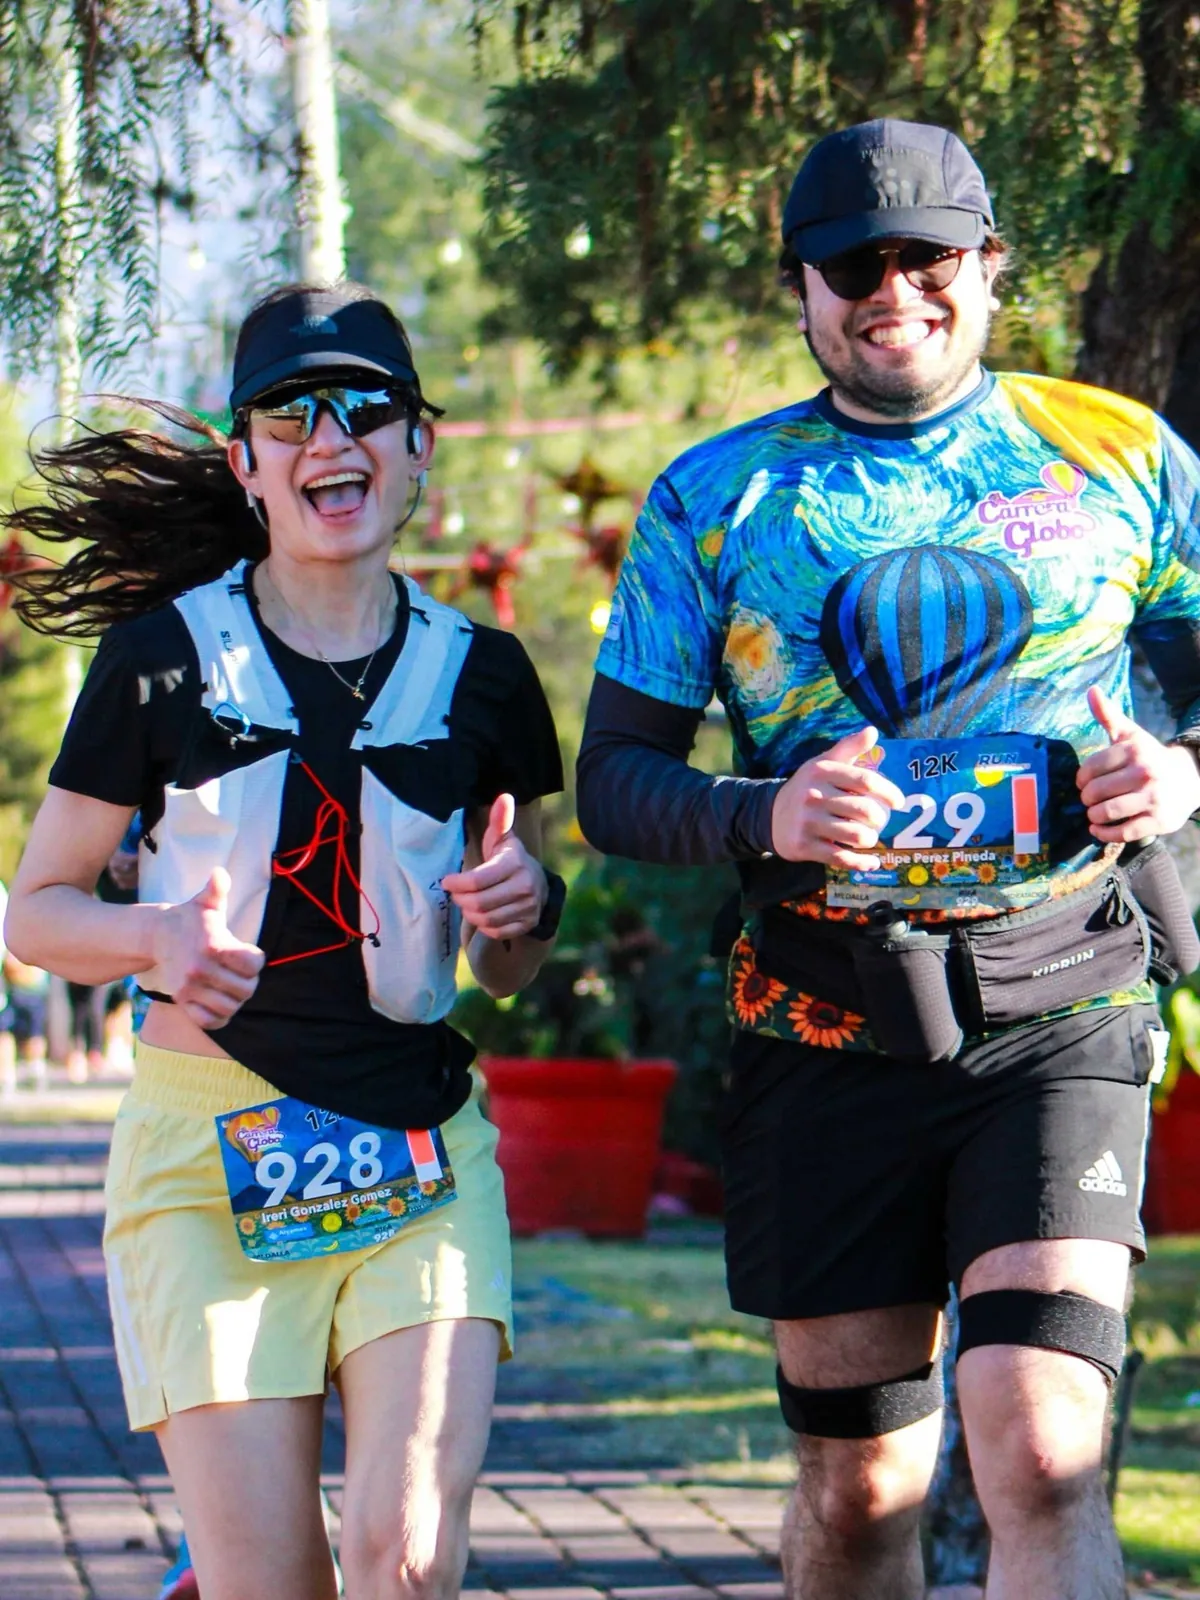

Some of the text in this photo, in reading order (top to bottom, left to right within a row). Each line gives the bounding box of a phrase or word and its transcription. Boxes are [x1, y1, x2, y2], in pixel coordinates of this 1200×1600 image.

[978, 493, 1070, 524] Carrera
[1003, 519, 1084, 558] Globo
[908, 751, 1020, 781] 12K RUN
[893, 791, 986, 849] 29
[913, 852, 950, 864] Perez
[952, 850, 996, 862] Pineda
[955, 896, 979, 907] 929
[1032, 948, 1095, 977] KIPRUN
[304, 1109, 345, 1132] 12
[247, 1137, 281, 1152] Globo
[255, 1131, 384, 1209] 928
[1078, 1177, 1127, 1197] adidas
[261, 1187, 393, 1223] Ireri Gonzalez Gomez
